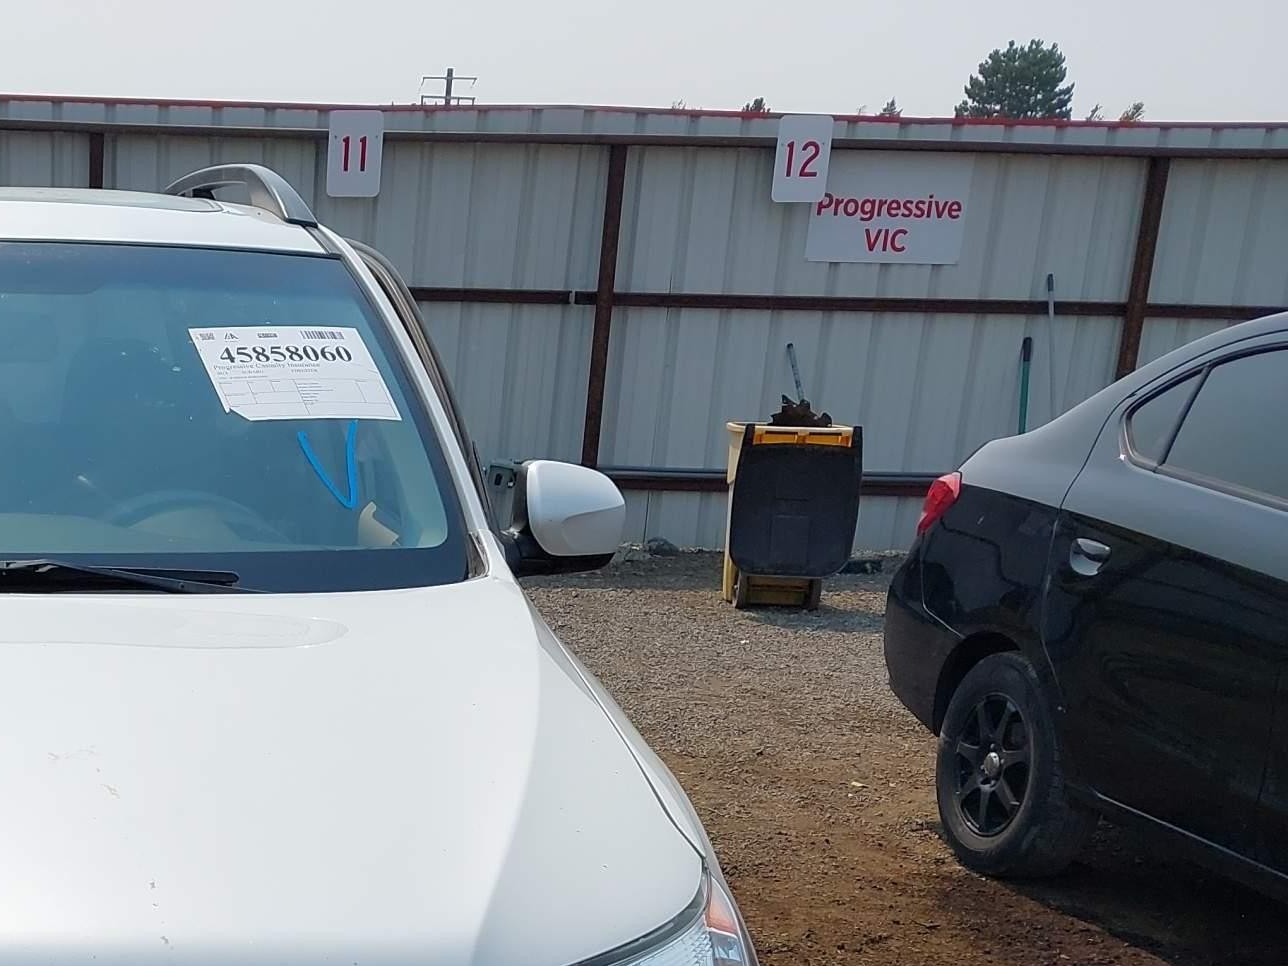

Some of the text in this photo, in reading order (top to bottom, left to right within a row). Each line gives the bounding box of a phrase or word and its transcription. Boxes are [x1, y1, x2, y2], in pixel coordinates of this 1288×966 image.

[342, 136, 367, 172] 11
[785, 141, 821, 178] 12
[816, 192, 962, 222] Progressive
[865, 228, 909, 253] VIC
[220, 345, 353, 363] 45858060
